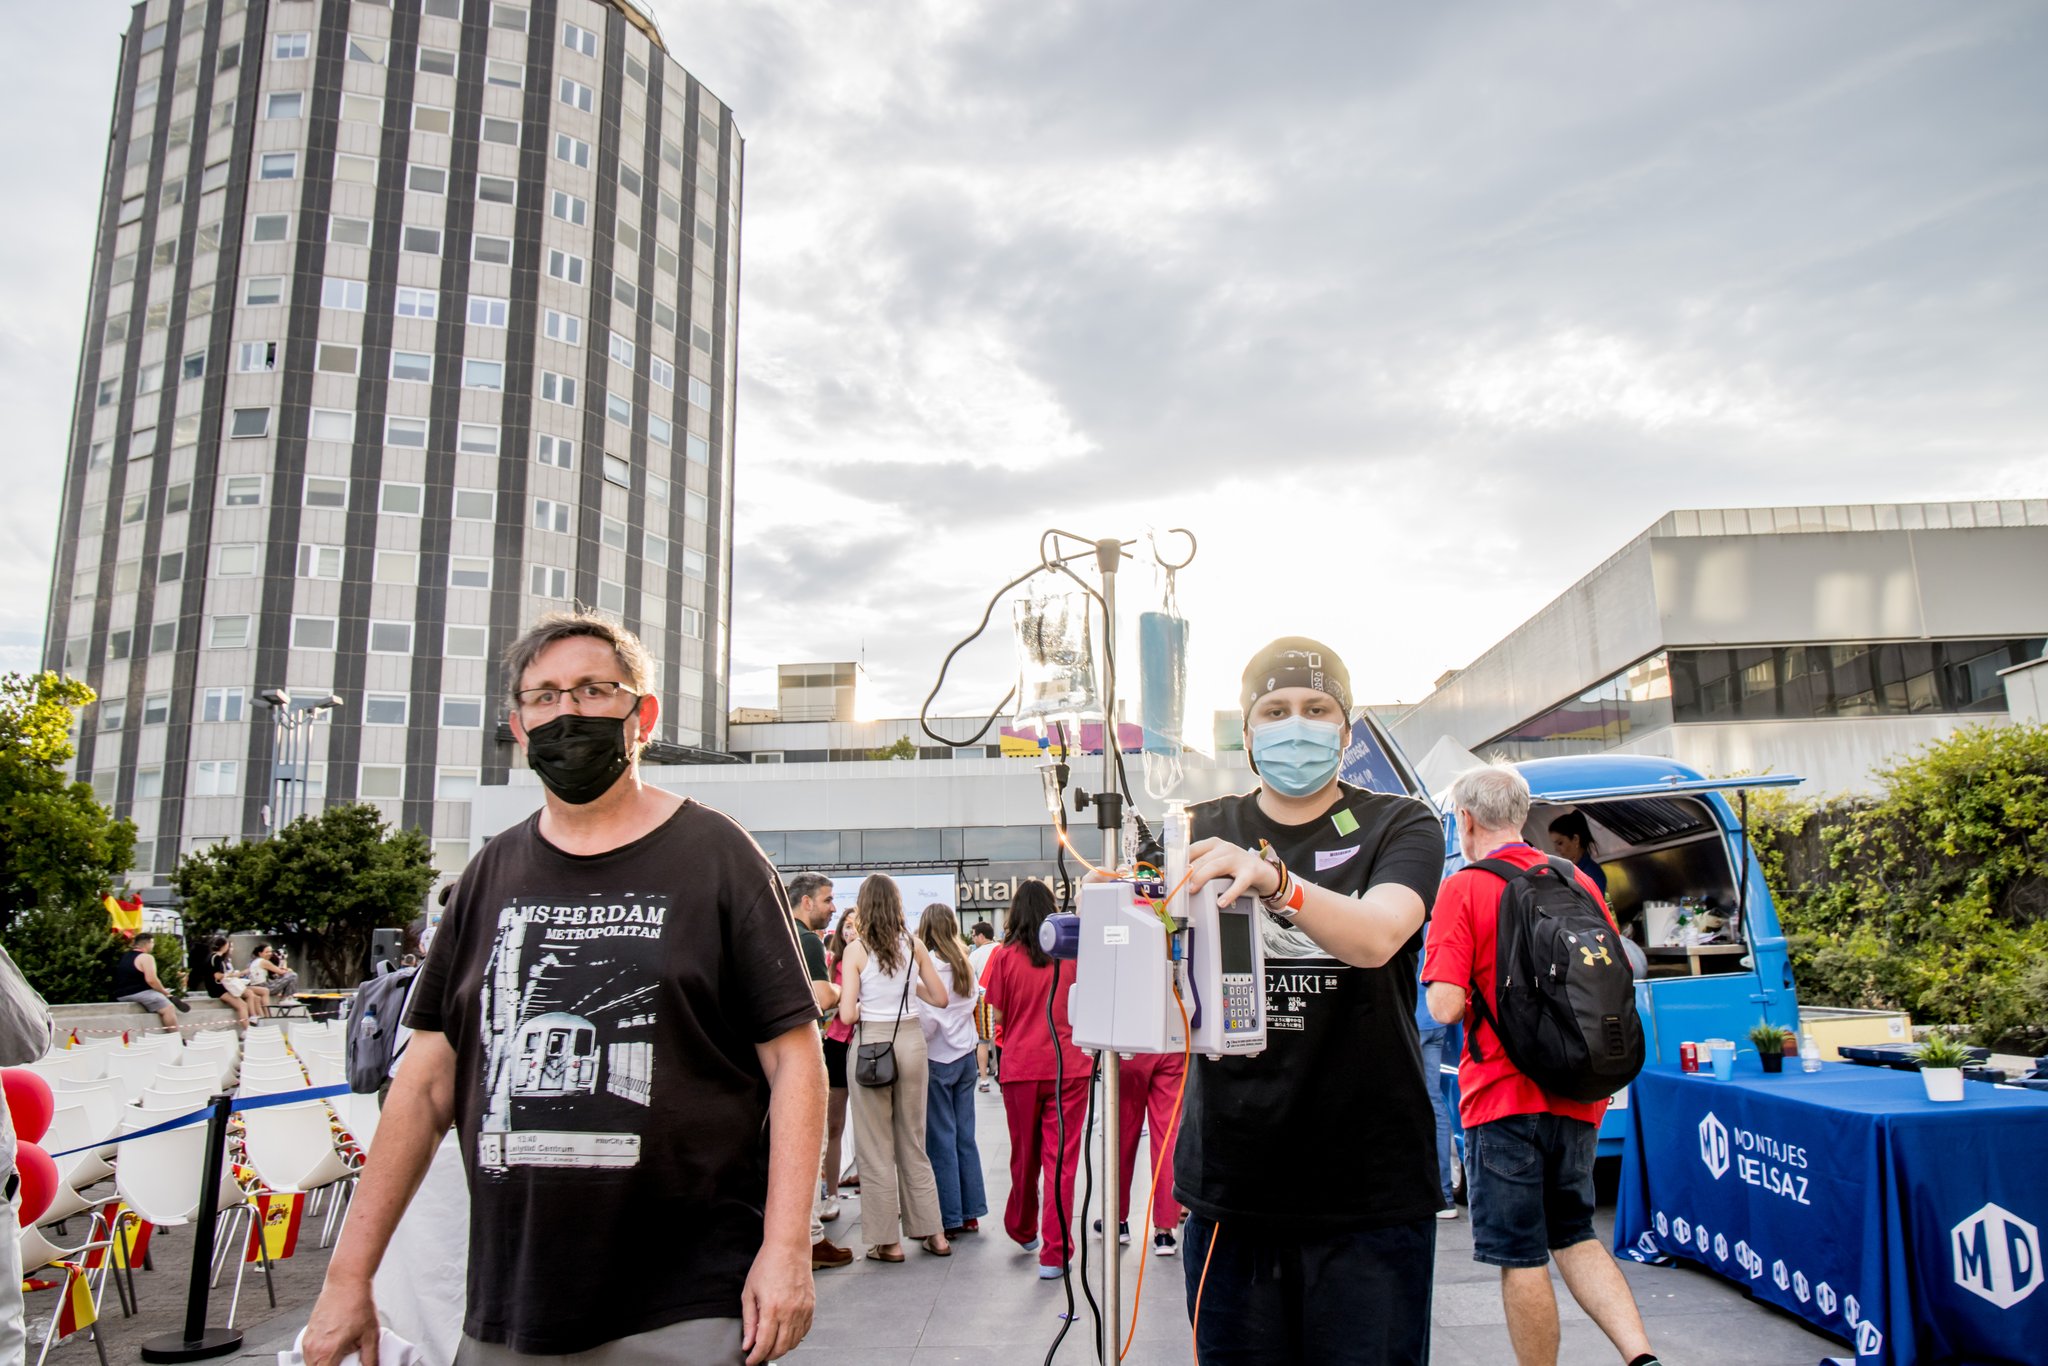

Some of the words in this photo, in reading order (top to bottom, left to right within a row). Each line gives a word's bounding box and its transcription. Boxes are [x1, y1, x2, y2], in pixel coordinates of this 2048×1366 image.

[956, 876, 1017, 906] pital
[502, 904, 667, 926] AMSTERDAM
[545, 925, 662, 940] METROPOLITAN
[482, 1144, 499, 1162] 15
[1737, 1153, 1811, 1205] DELSAZ
[1955, 1214, 2037, 1298] MD
